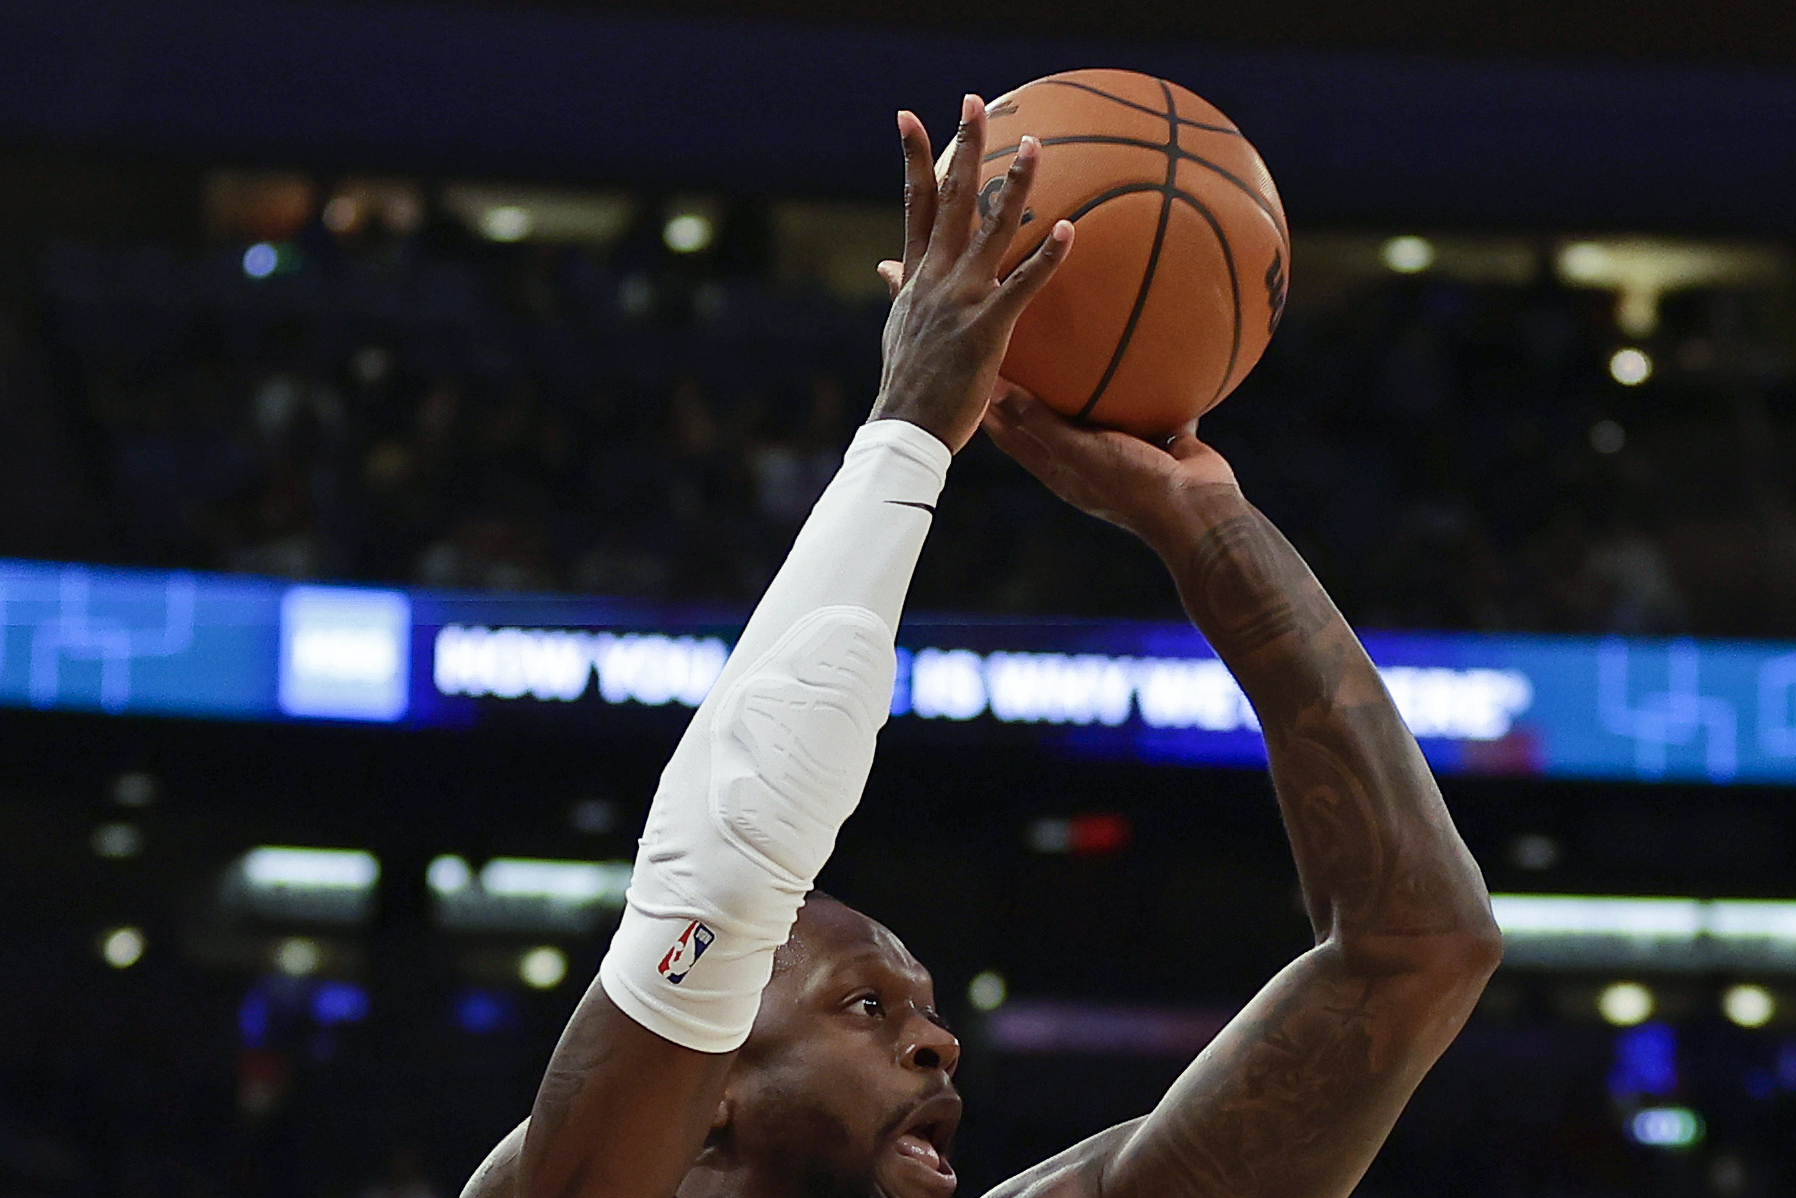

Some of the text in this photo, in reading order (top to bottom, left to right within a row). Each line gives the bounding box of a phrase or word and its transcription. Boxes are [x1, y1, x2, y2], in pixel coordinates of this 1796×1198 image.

[434, 625, 594, 700] HOW
[911, 650, 981, 718] IS
[984, 652, 1132, 725] WHY
